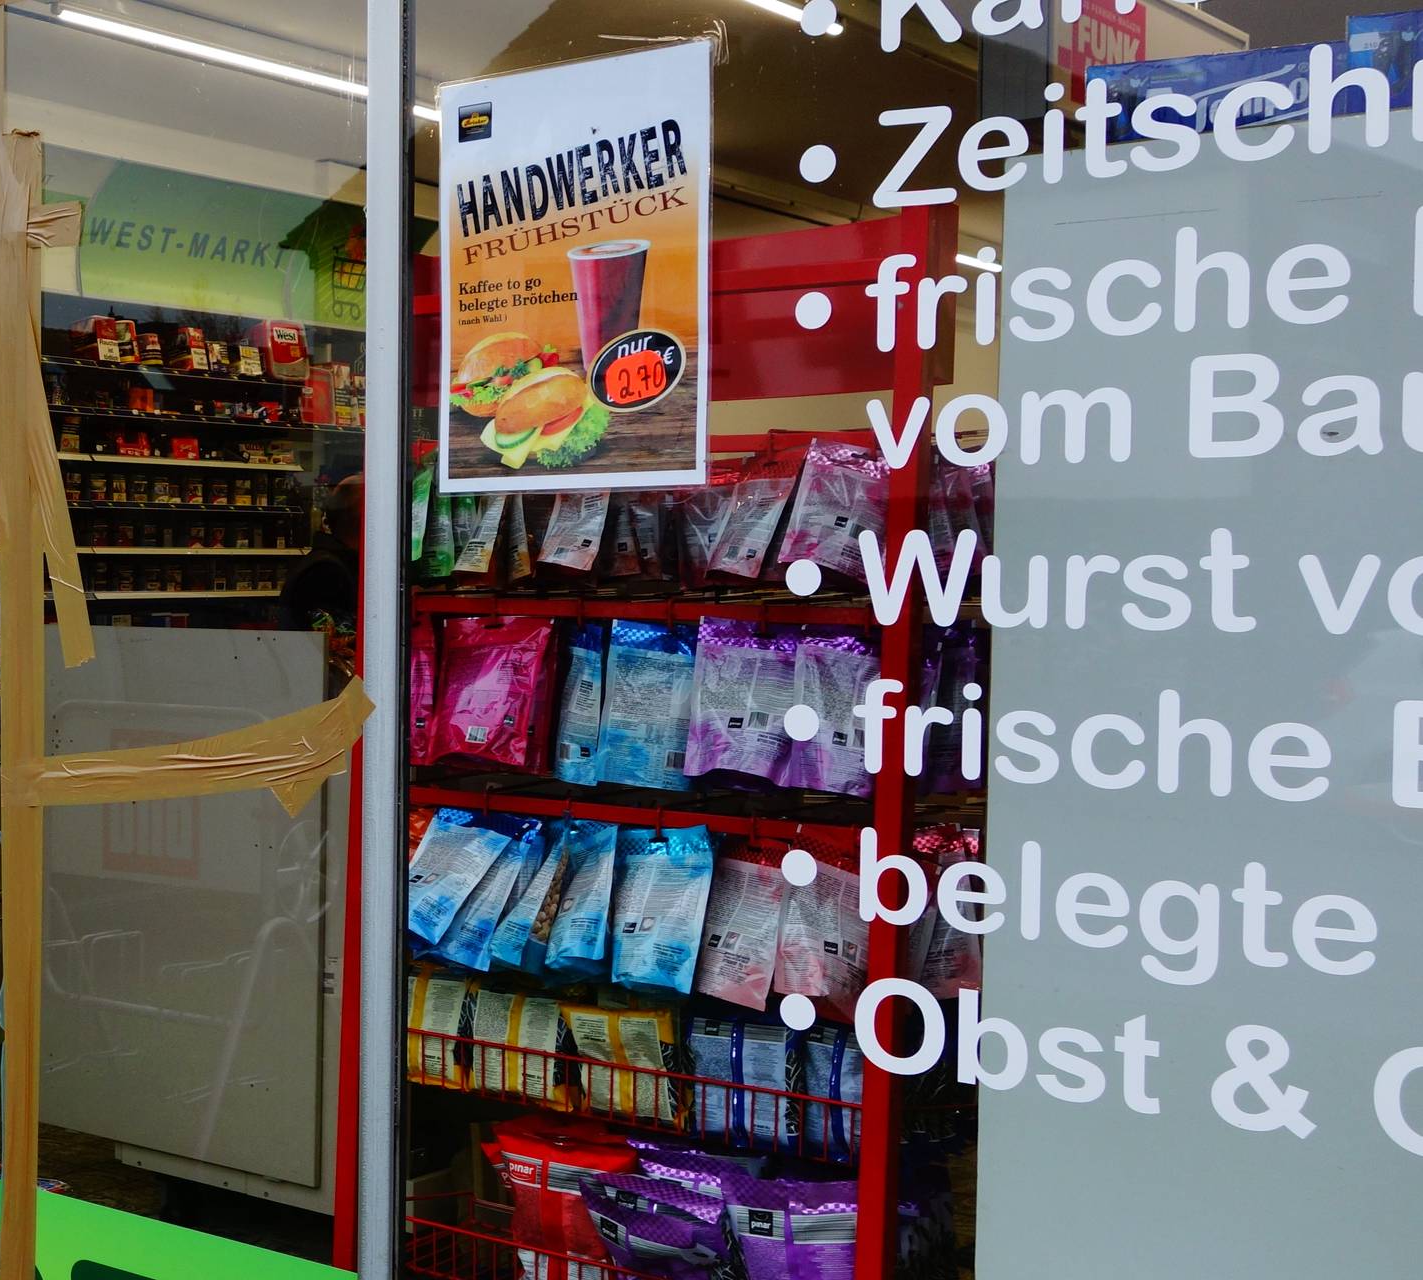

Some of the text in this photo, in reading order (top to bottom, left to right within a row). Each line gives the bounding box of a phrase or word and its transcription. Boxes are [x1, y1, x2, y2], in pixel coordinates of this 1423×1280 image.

[456, 118, 687, 238] HANDWERKER
[872, 44, 1423, 209] Zeitsch
[89, 217, 288, 269] WEST-MARKT
[463, 187, 688, 266] FRÜHSTÜCK
[275, 328, 297, 341] West
[458, 276, 542, 298] Kaffee to go
[458, 289, 578, 314] belegte Brötchen
[865, 226, 1352, 353] frische
[617, 335, 653, 358] nur
[618, 361, 664, 399] 2,70
[866, 353, 1423, 470] vom Ba
[858, 527, 1258, 633] Wurst
[853, 678, 1332, 802] frische
[859, 826, 1378, 986] belegte
[854, 977, 1161, 1115] Obst
[1211, 1024, 1317, 1140] &
